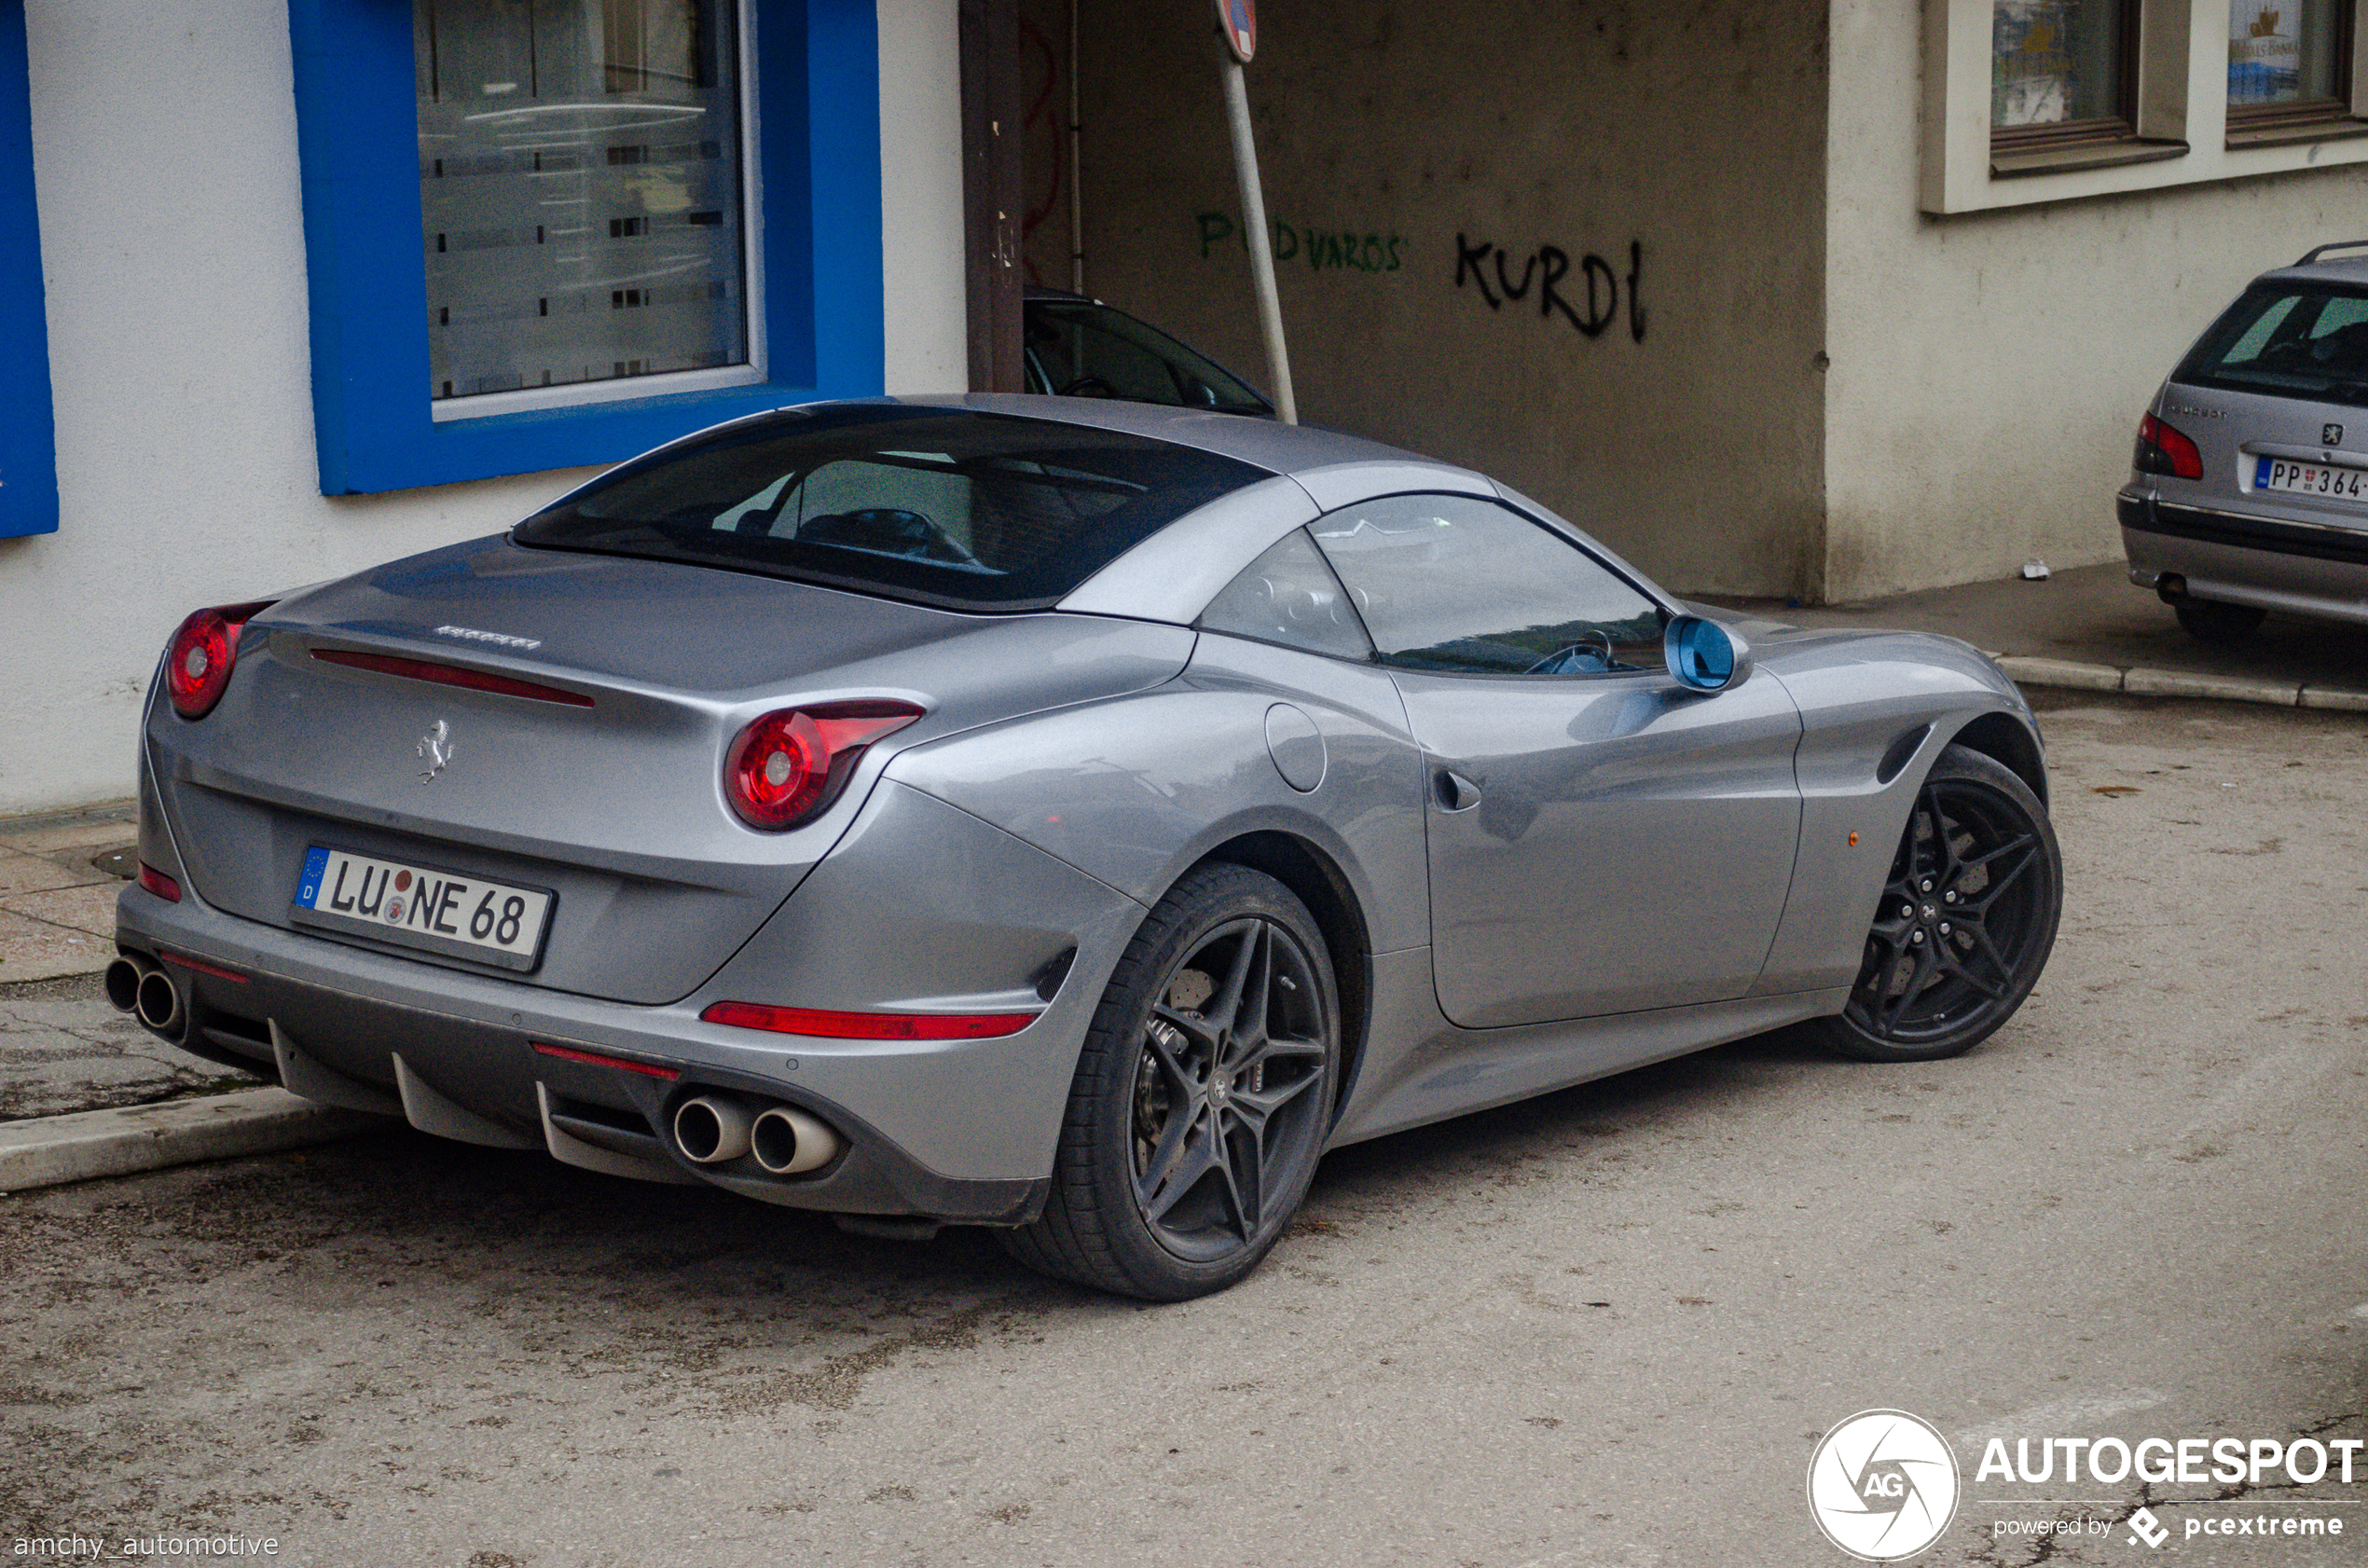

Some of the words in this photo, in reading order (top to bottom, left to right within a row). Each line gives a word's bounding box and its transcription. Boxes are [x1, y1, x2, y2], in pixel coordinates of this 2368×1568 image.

[1455, 232, 1645, 344] KURDI
[2273, 463, 2300, 488] PP
[303, 885, 312, 900] D
[330, 860, 391, 917] LU
[407, 876, 468, 935] NE
[470, 890, 526, 945] 68
